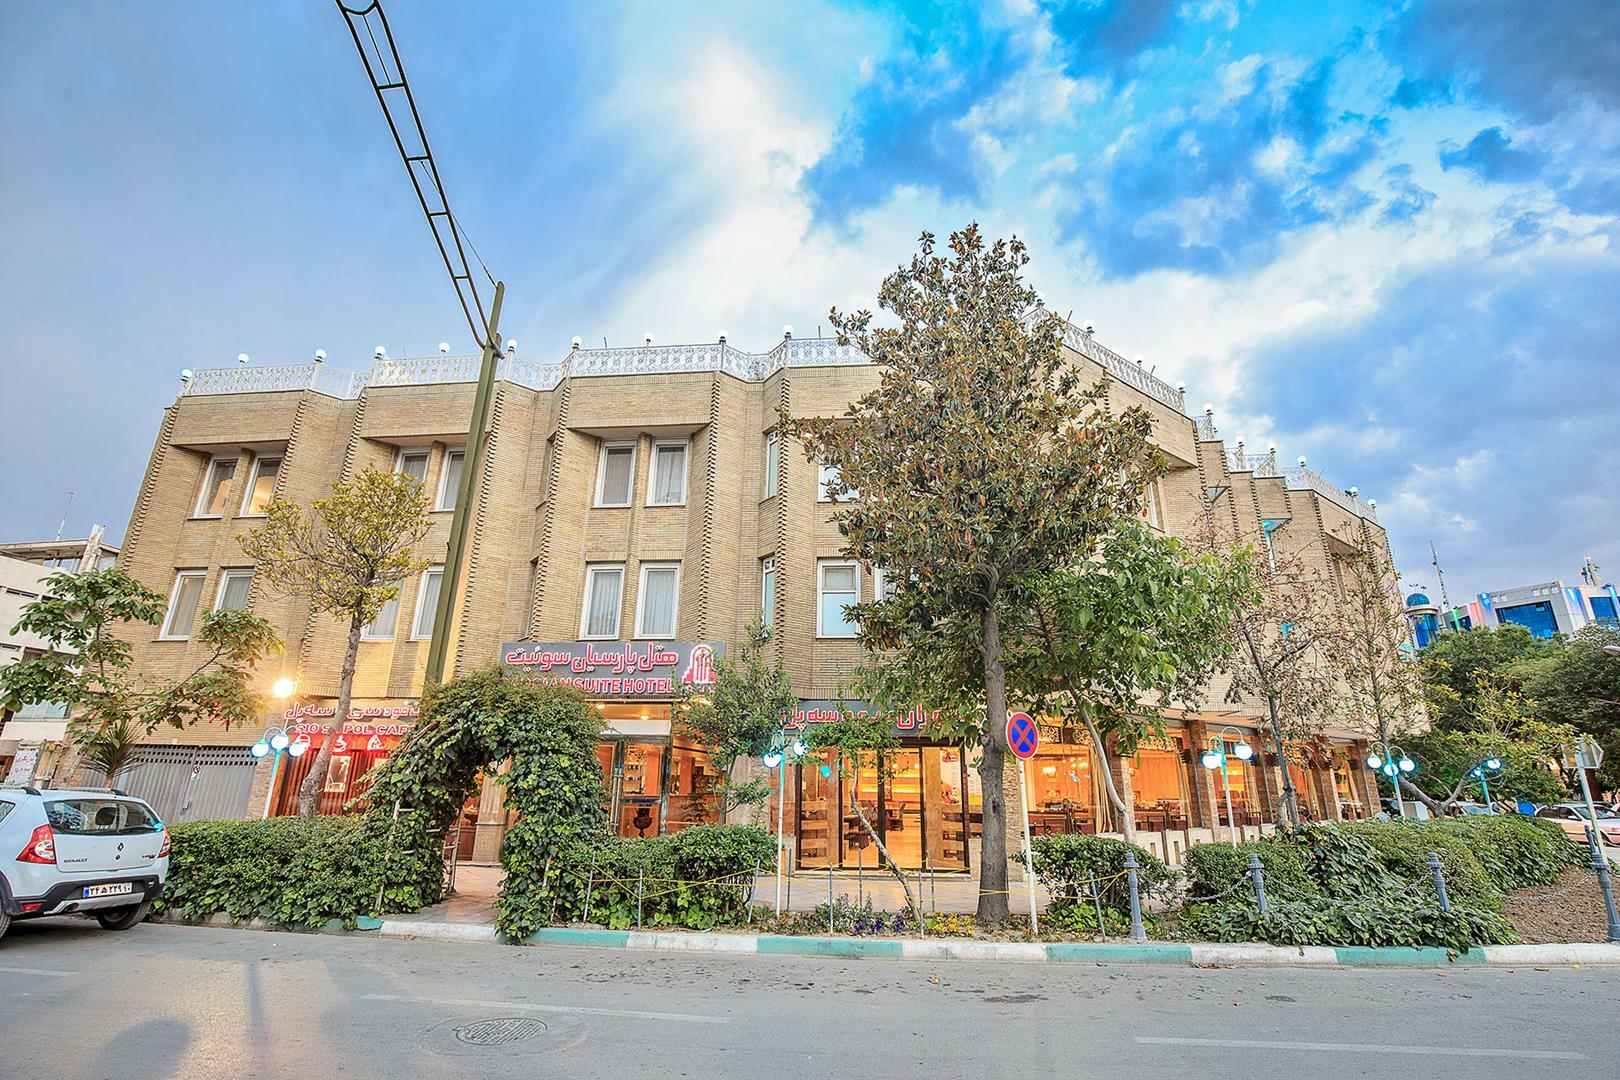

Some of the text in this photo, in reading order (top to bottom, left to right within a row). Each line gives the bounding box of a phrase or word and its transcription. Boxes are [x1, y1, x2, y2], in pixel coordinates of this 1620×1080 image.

[505, 644, 678, 674] هتل پارسیان سوئیت
[573, 677, 621, 693] SUITE
[622, 678, 674, 693] HOTEL
[342, 723, 373, 735] POL
